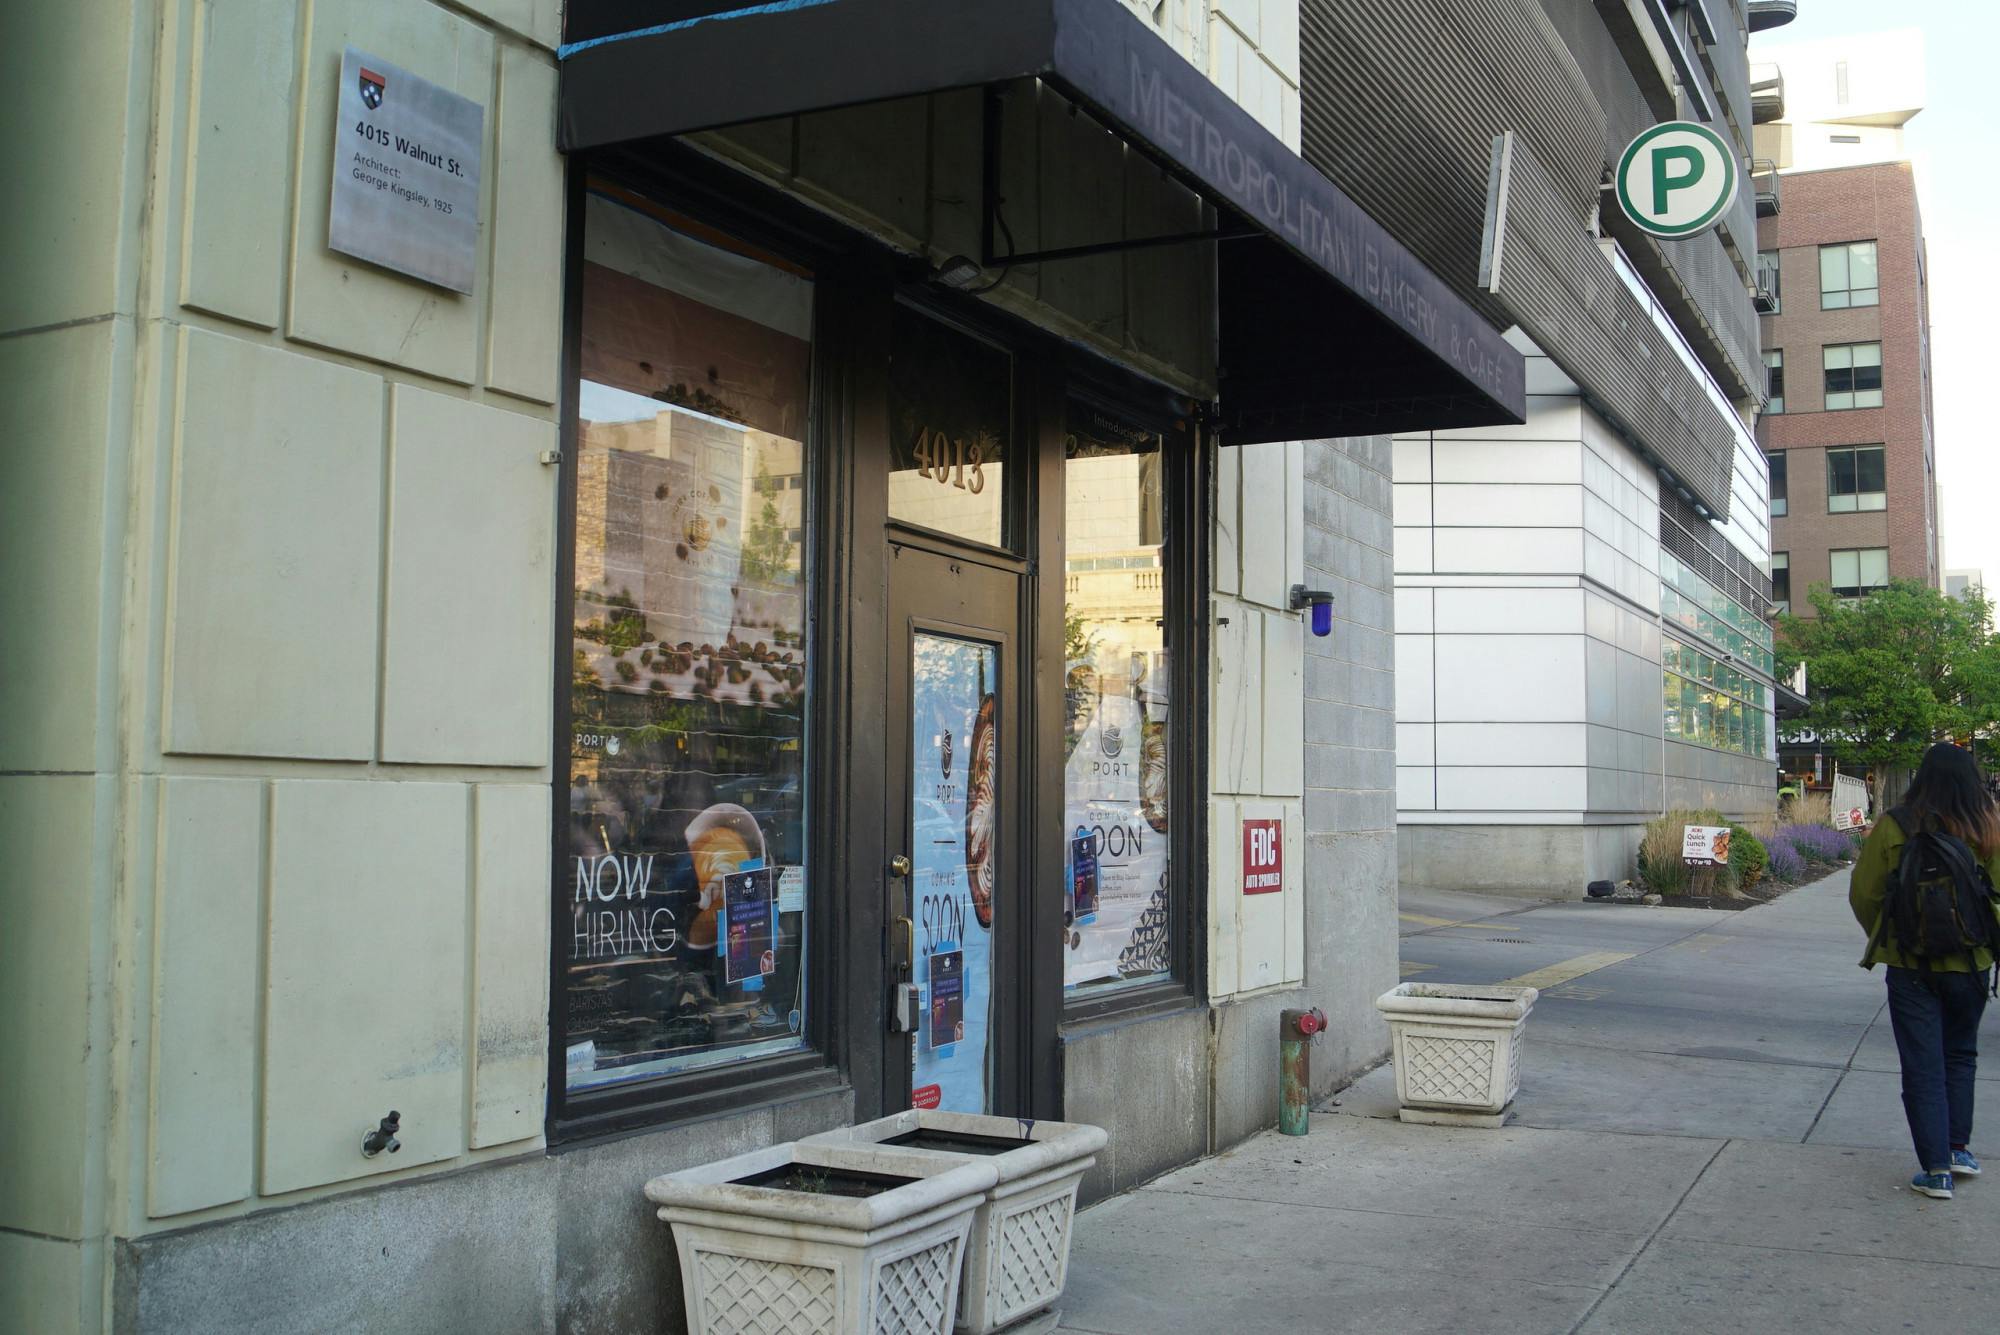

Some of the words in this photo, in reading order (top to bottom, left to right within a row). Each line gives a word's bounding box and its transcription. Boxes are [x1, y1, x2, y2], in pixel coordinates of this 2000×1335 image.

[354, 152, 401, 179] Architect:
[355, 121, 390, 147] 4015
[395, 135, 443, 170] Walnut
[447, 158, 465, 178] St.
[352, 168, 388, 192] George
[390, 181, 431, 208] Kingsley,
[433, 198, 453, 215] 1925
[1651, 145, 1705, 215] P
[1128, 51, 1352, 276] METROPOLITAN
[1364, 239, 1438, 342] BAKERY
[1450, 328, 1463, 364] &
[913, 426, 985, 495] 4013
[576, 733, 606, 747] PORT
[1092, 761, 1129, 777] PORT
[936, 785, 956, 805] PORT
[1075, 824, 1143, 858] OON
[1250, 827, 1276, 866] FDC
[1687, 833, 1706, 841] Quick
[574, 855, 653, 903] NOW
[573, 907, 677, 959] HIRING
[922, 892, 966, 957] SOON
